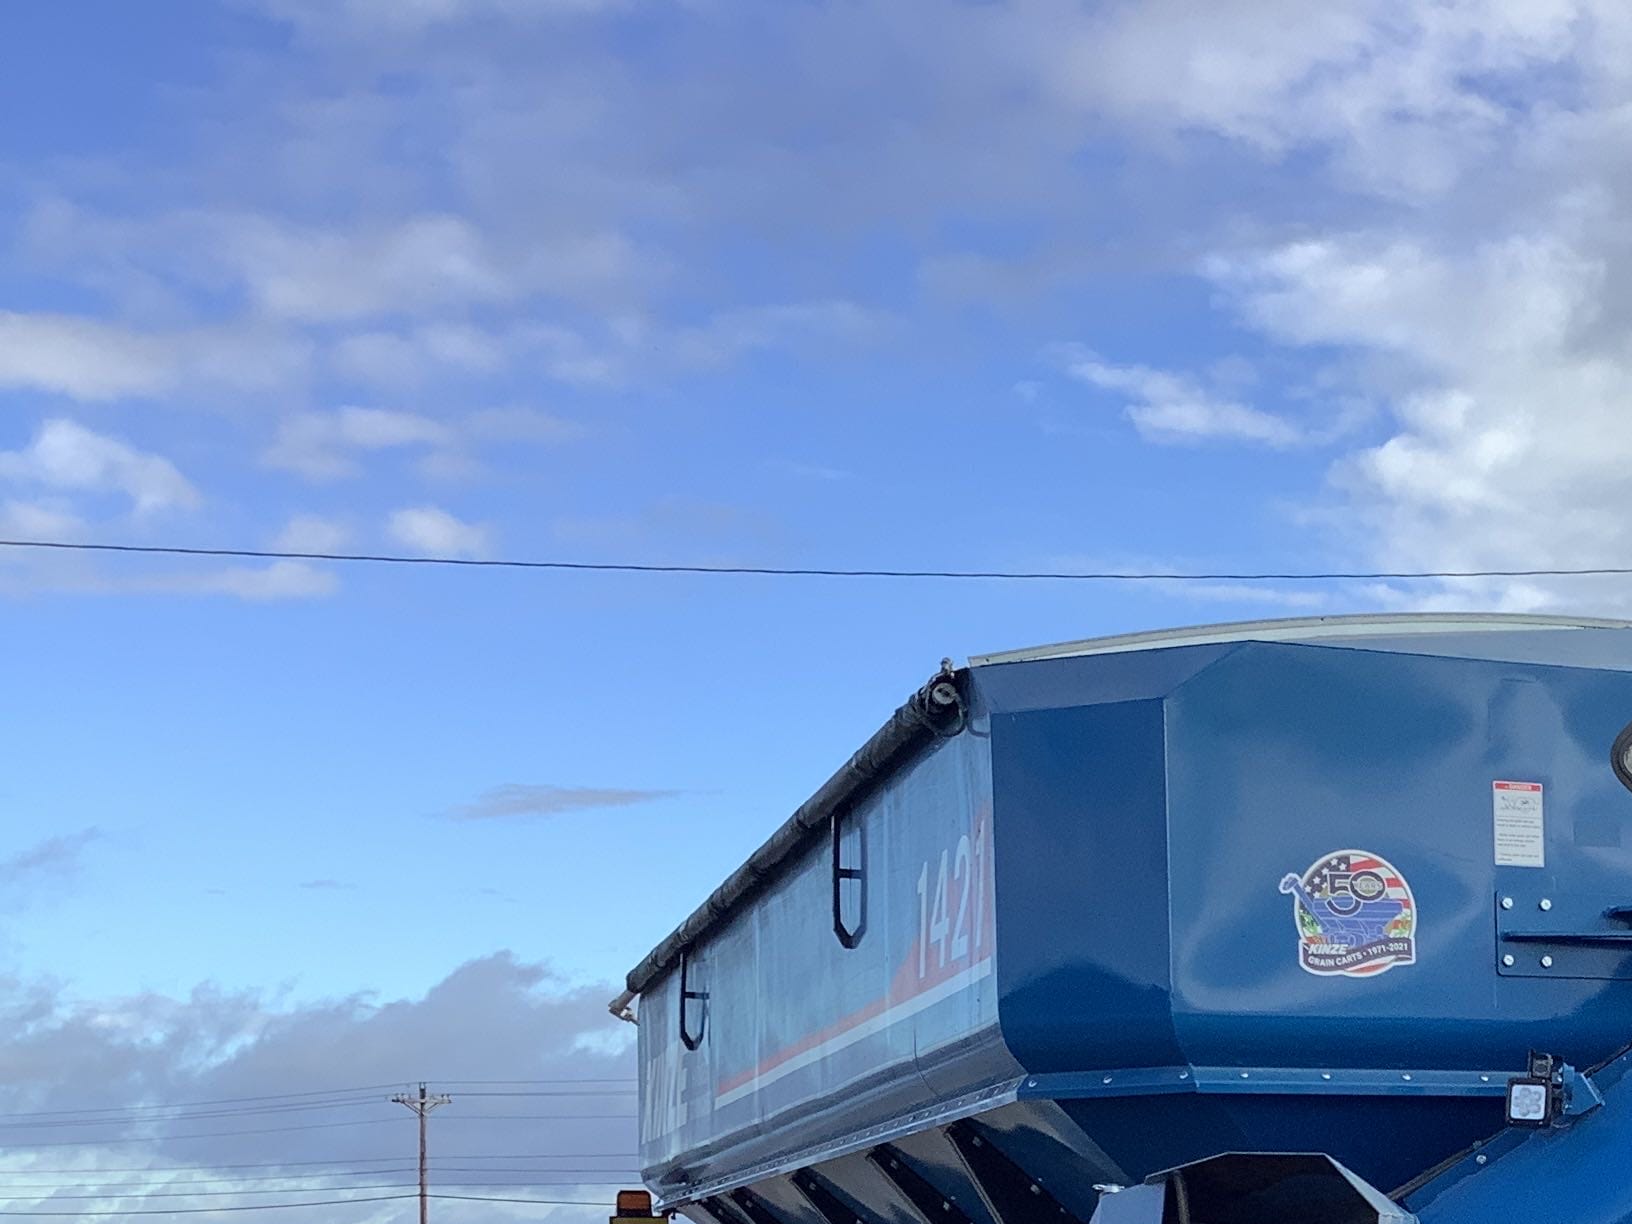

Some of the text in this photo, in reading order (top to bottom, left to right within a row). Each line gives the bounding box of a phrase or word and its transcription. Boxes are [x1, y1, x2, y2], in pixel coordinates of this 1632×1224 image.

[917, 819, 985, 979] 1421
[1325, 869, 1386, 917] 50
[1307, 942, 1409, 967] GRAIN CARTS 1971-2021
[1308, 944, 1348, 955] KINZE
